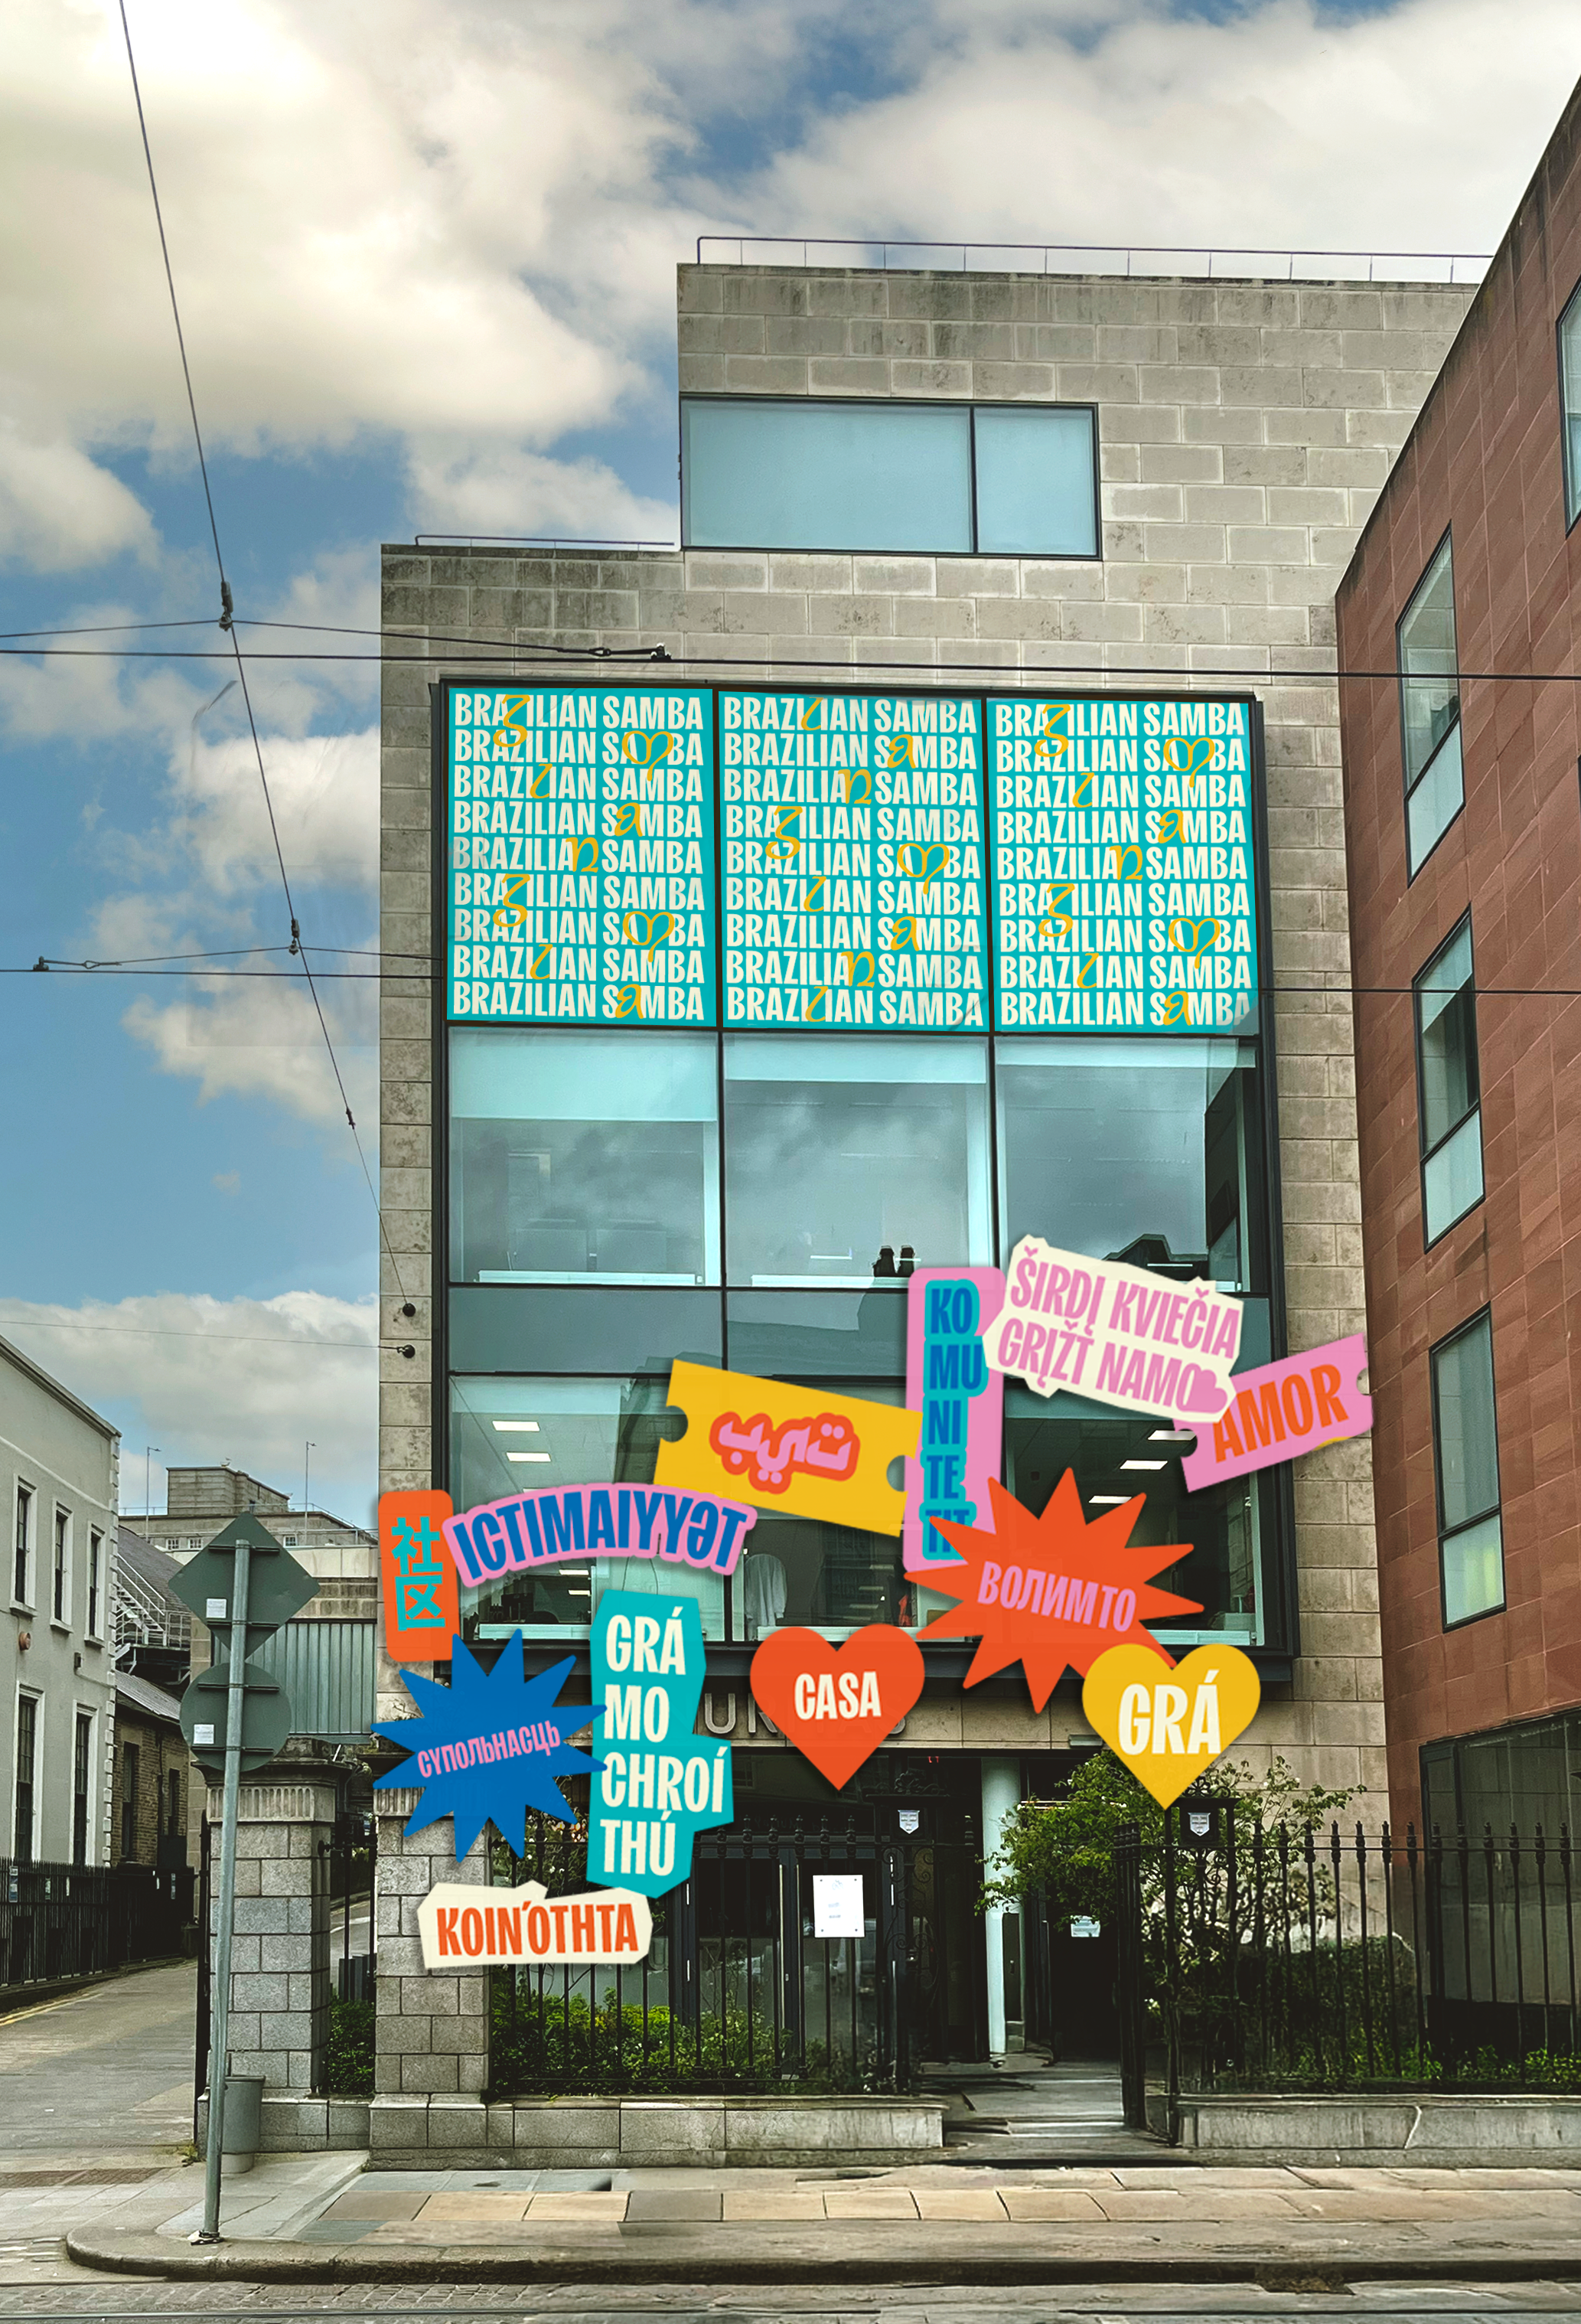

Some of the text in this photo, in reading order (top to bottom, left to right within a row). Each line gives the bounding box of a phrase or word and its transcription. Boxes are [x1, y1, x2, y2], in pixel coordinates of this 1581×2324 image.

[603, 696, 702, 730] SAMBA
[875, 700, 976, 733] SAMBA
[1144, 703, 1244, 736] SAMBA
[725, 733, 867, 766] BRAZILIAN
[603, 768, 702, 801] SAMBA
[875, 772, 977, 805] SAMBA
[1146, 775, 1245, 807] SAMBA
[455, 801, 595, 834] BRAZILIAN
[878, 808, 980, 841] SAMBA
[998, 811, 1138, 844] BRAZILIAN
[602, 840, 702, 873] SAMBA
[1146, 847, 1247, 880] SAMBA
[604, 876, 704, 910] SAMBA
[878, 880, 980, 915] SAMBA
[1149, 883, 1250, 916] SAMBA
[727, 914, 870, 948] BRAZILIAN
[603, 948, 704, 983] SAMBA
[879, 954, 983, 989] SAMBA
[1150, 956, 1251, 988] SAMBA
[454, 981, 595, 1017] BRAZILIAN
[880, 991, 983, 1026] SAMBA
[1002, 992, 1143, 1024] BRAZILIAN
